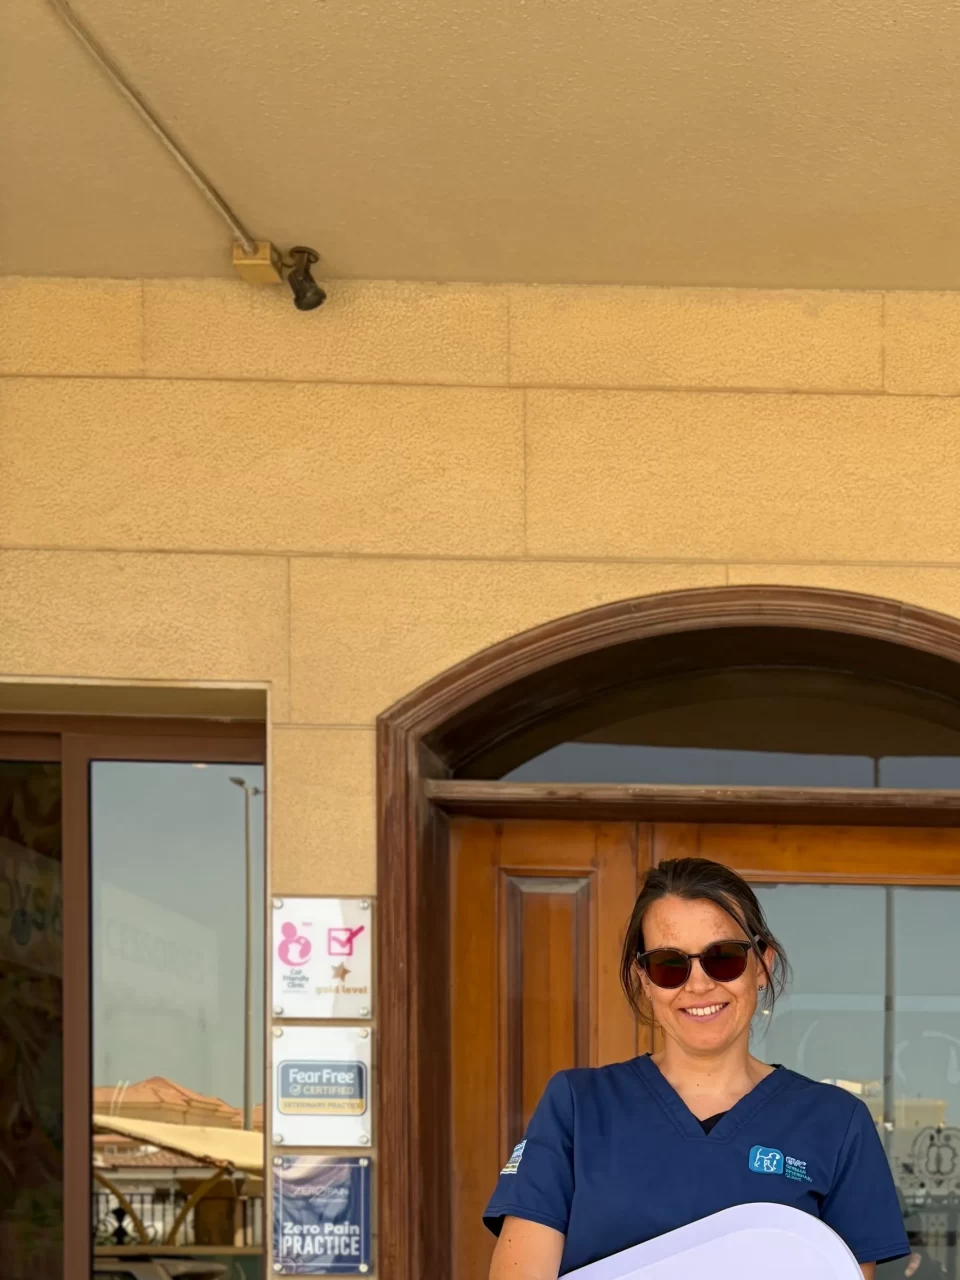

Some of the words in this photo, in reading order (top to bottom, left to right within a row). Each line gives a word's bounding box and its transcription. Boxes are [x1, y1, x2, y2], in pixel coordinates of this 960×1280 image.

[342, 985, 367, 994] level
[288, 1068, 321, 1084] Fear
[322, 1068, 354, 1084] Free
[283, 1222, 320, 1234] Zero
[323, 1221, 360, 1235] Pain
[282, 1235, 360, 1256] PRACTICE
